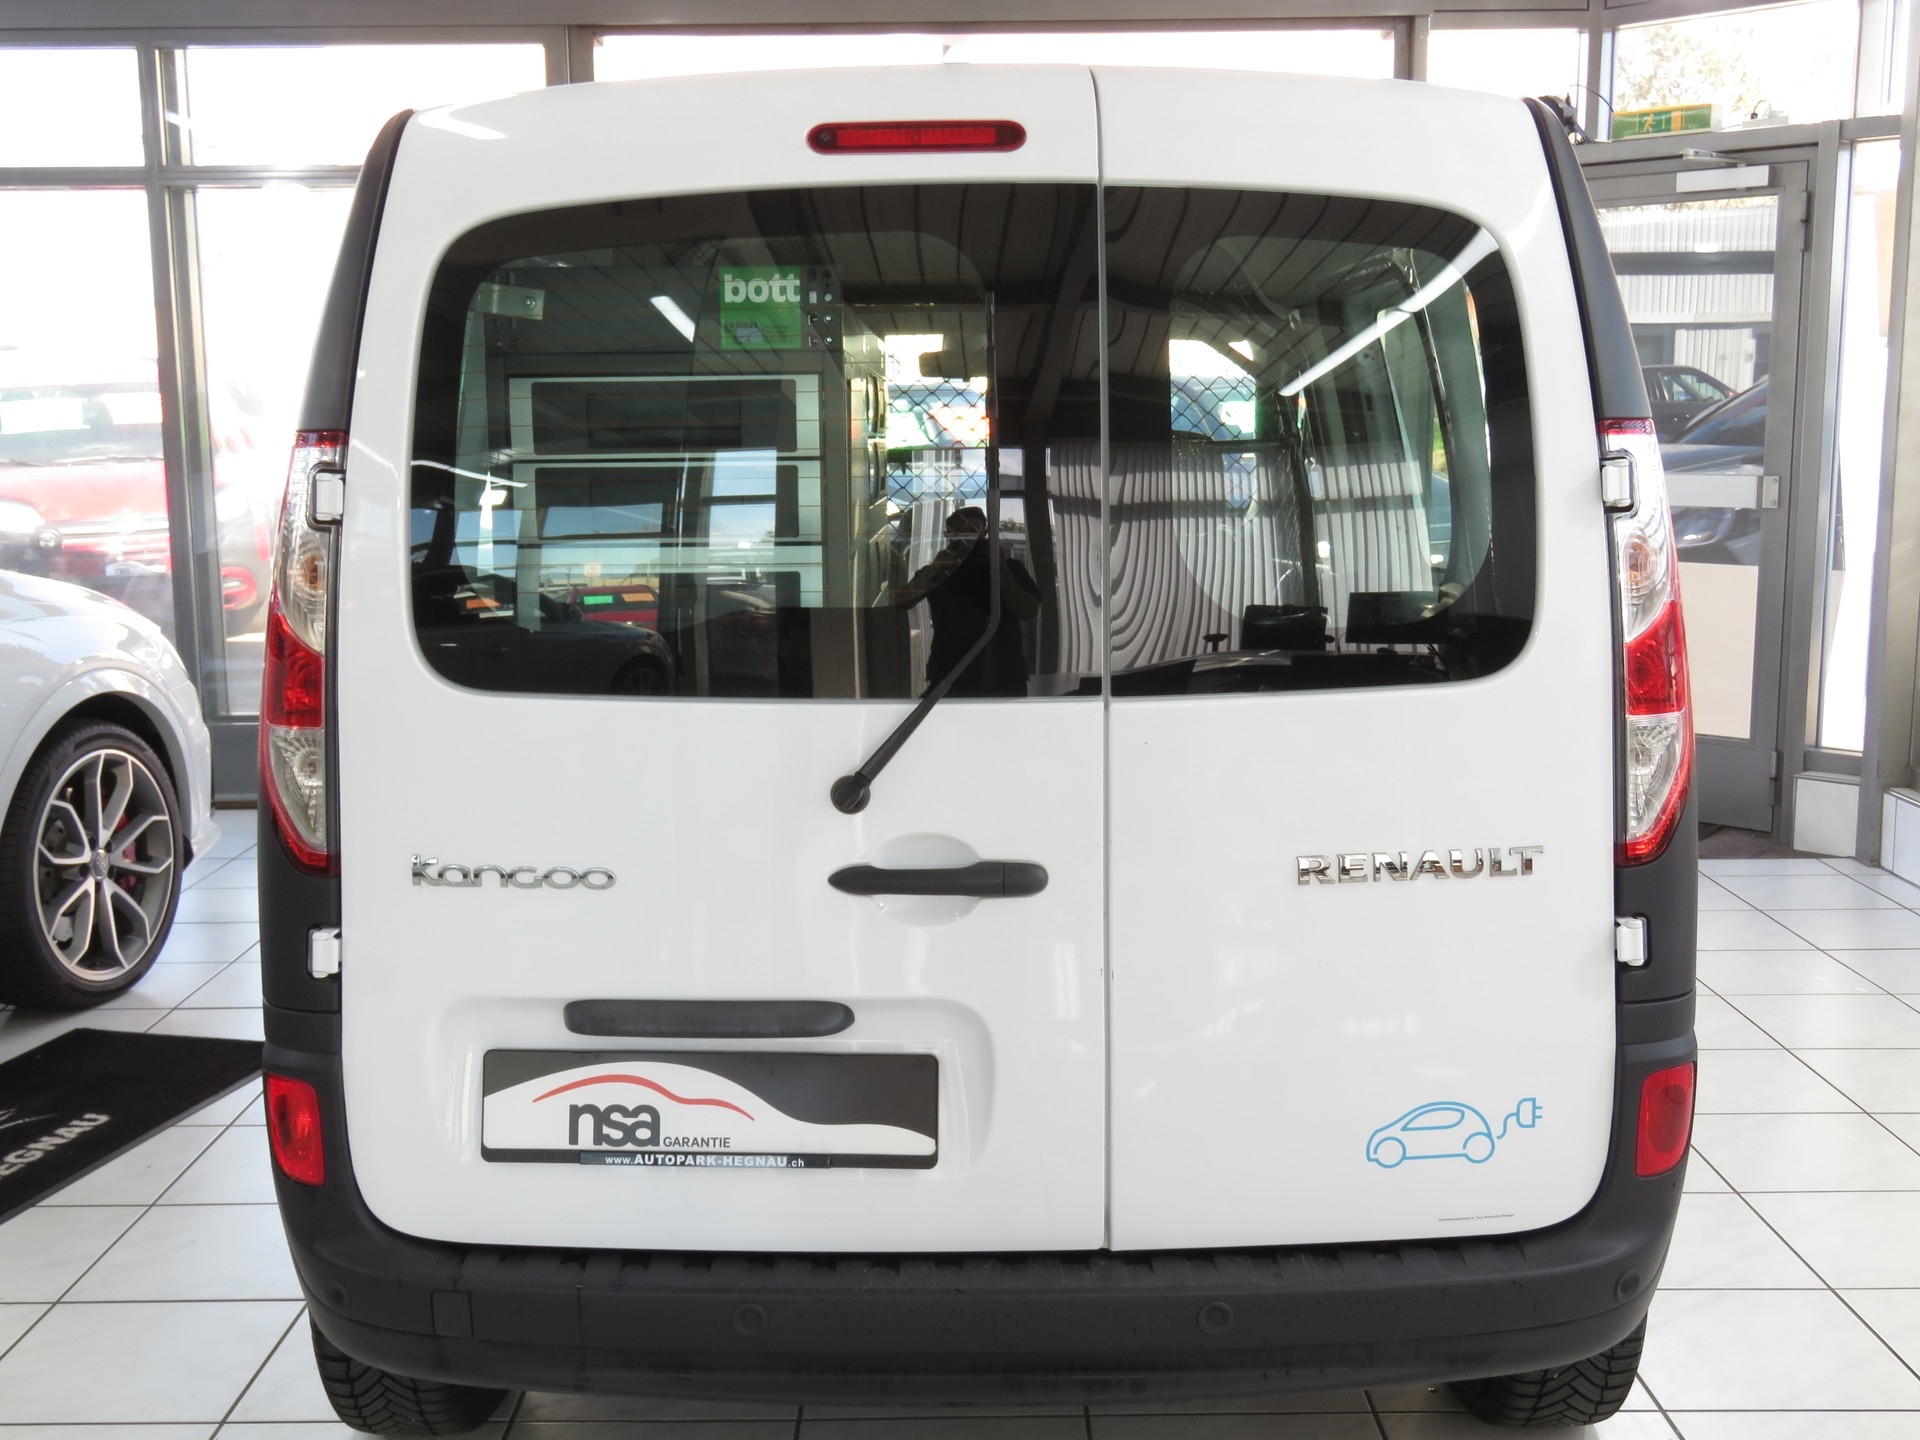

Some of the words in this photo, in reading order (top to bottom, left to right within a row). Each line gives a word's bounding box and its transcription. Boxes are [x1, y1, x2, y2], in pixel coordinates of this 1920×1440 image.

[724, 273, 801, 303] bott
[1296, 845, 1545, 885] RENAULT
[568, 1103, 661, 1148] nsa
[663, 1136, 731, 1149] GARANTIE
[0, 1113, 110, 1181] EGNAU
[604, 1153, 805, 1169] www.AUTOPARK-HEGNAU.ch
